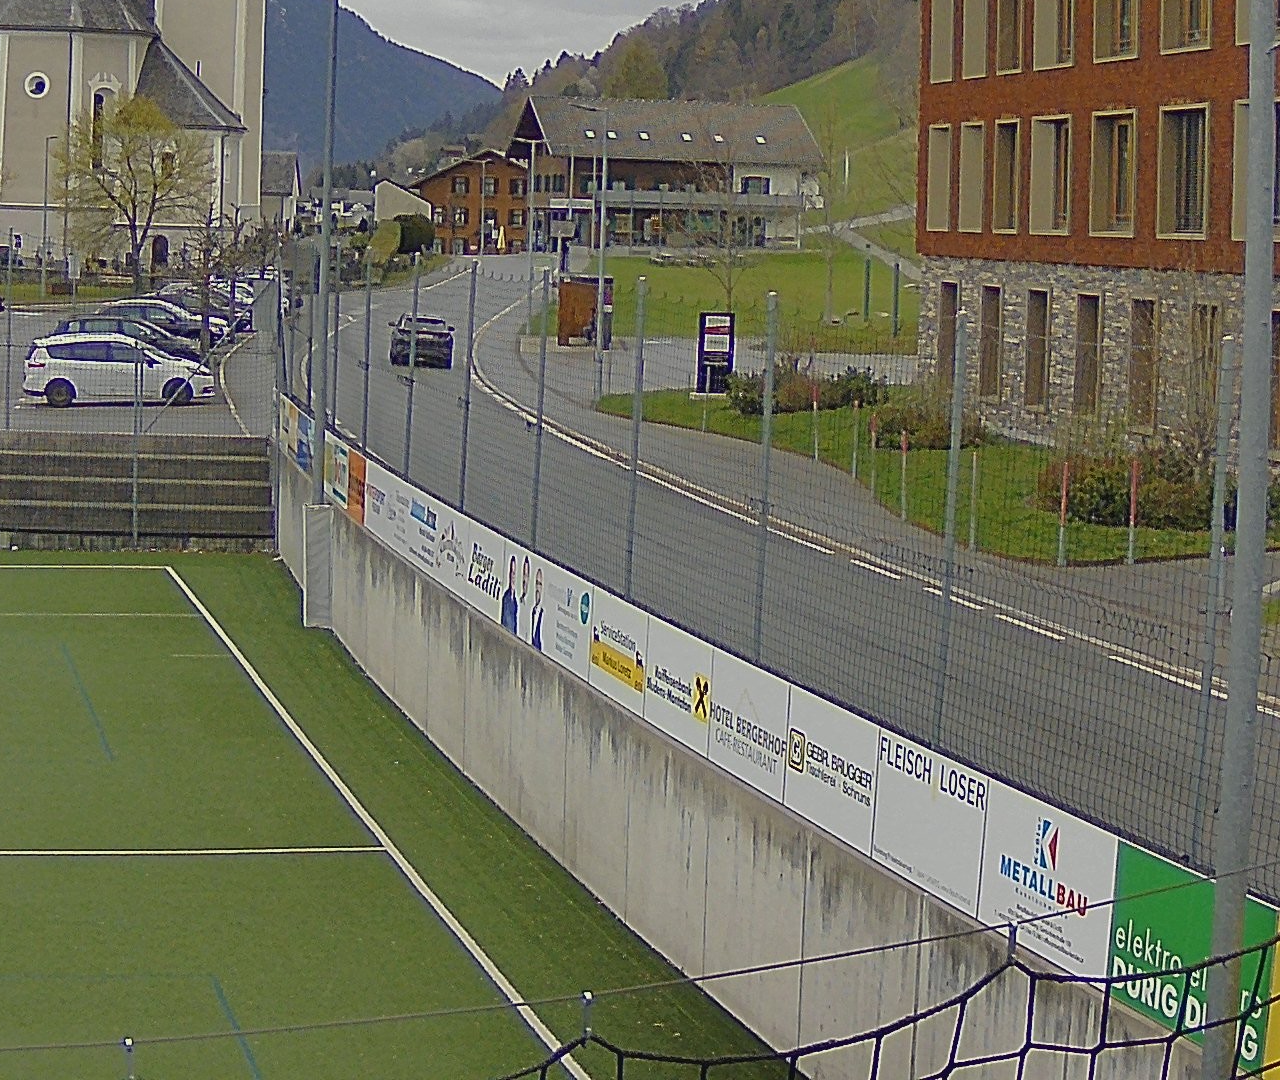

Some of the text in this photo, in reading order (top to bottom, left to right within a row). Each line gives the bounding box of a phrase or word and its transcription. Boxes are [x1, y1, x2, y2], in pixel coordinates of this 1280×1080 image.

[710, 701, 787, 758] HOTEL BERGERHOF
[880, 736, 986, 811] FLEISCH LOSER
[1000, 854, 1088, 916] METALLBAU
[1115, 919, 1182, 978] elektro
